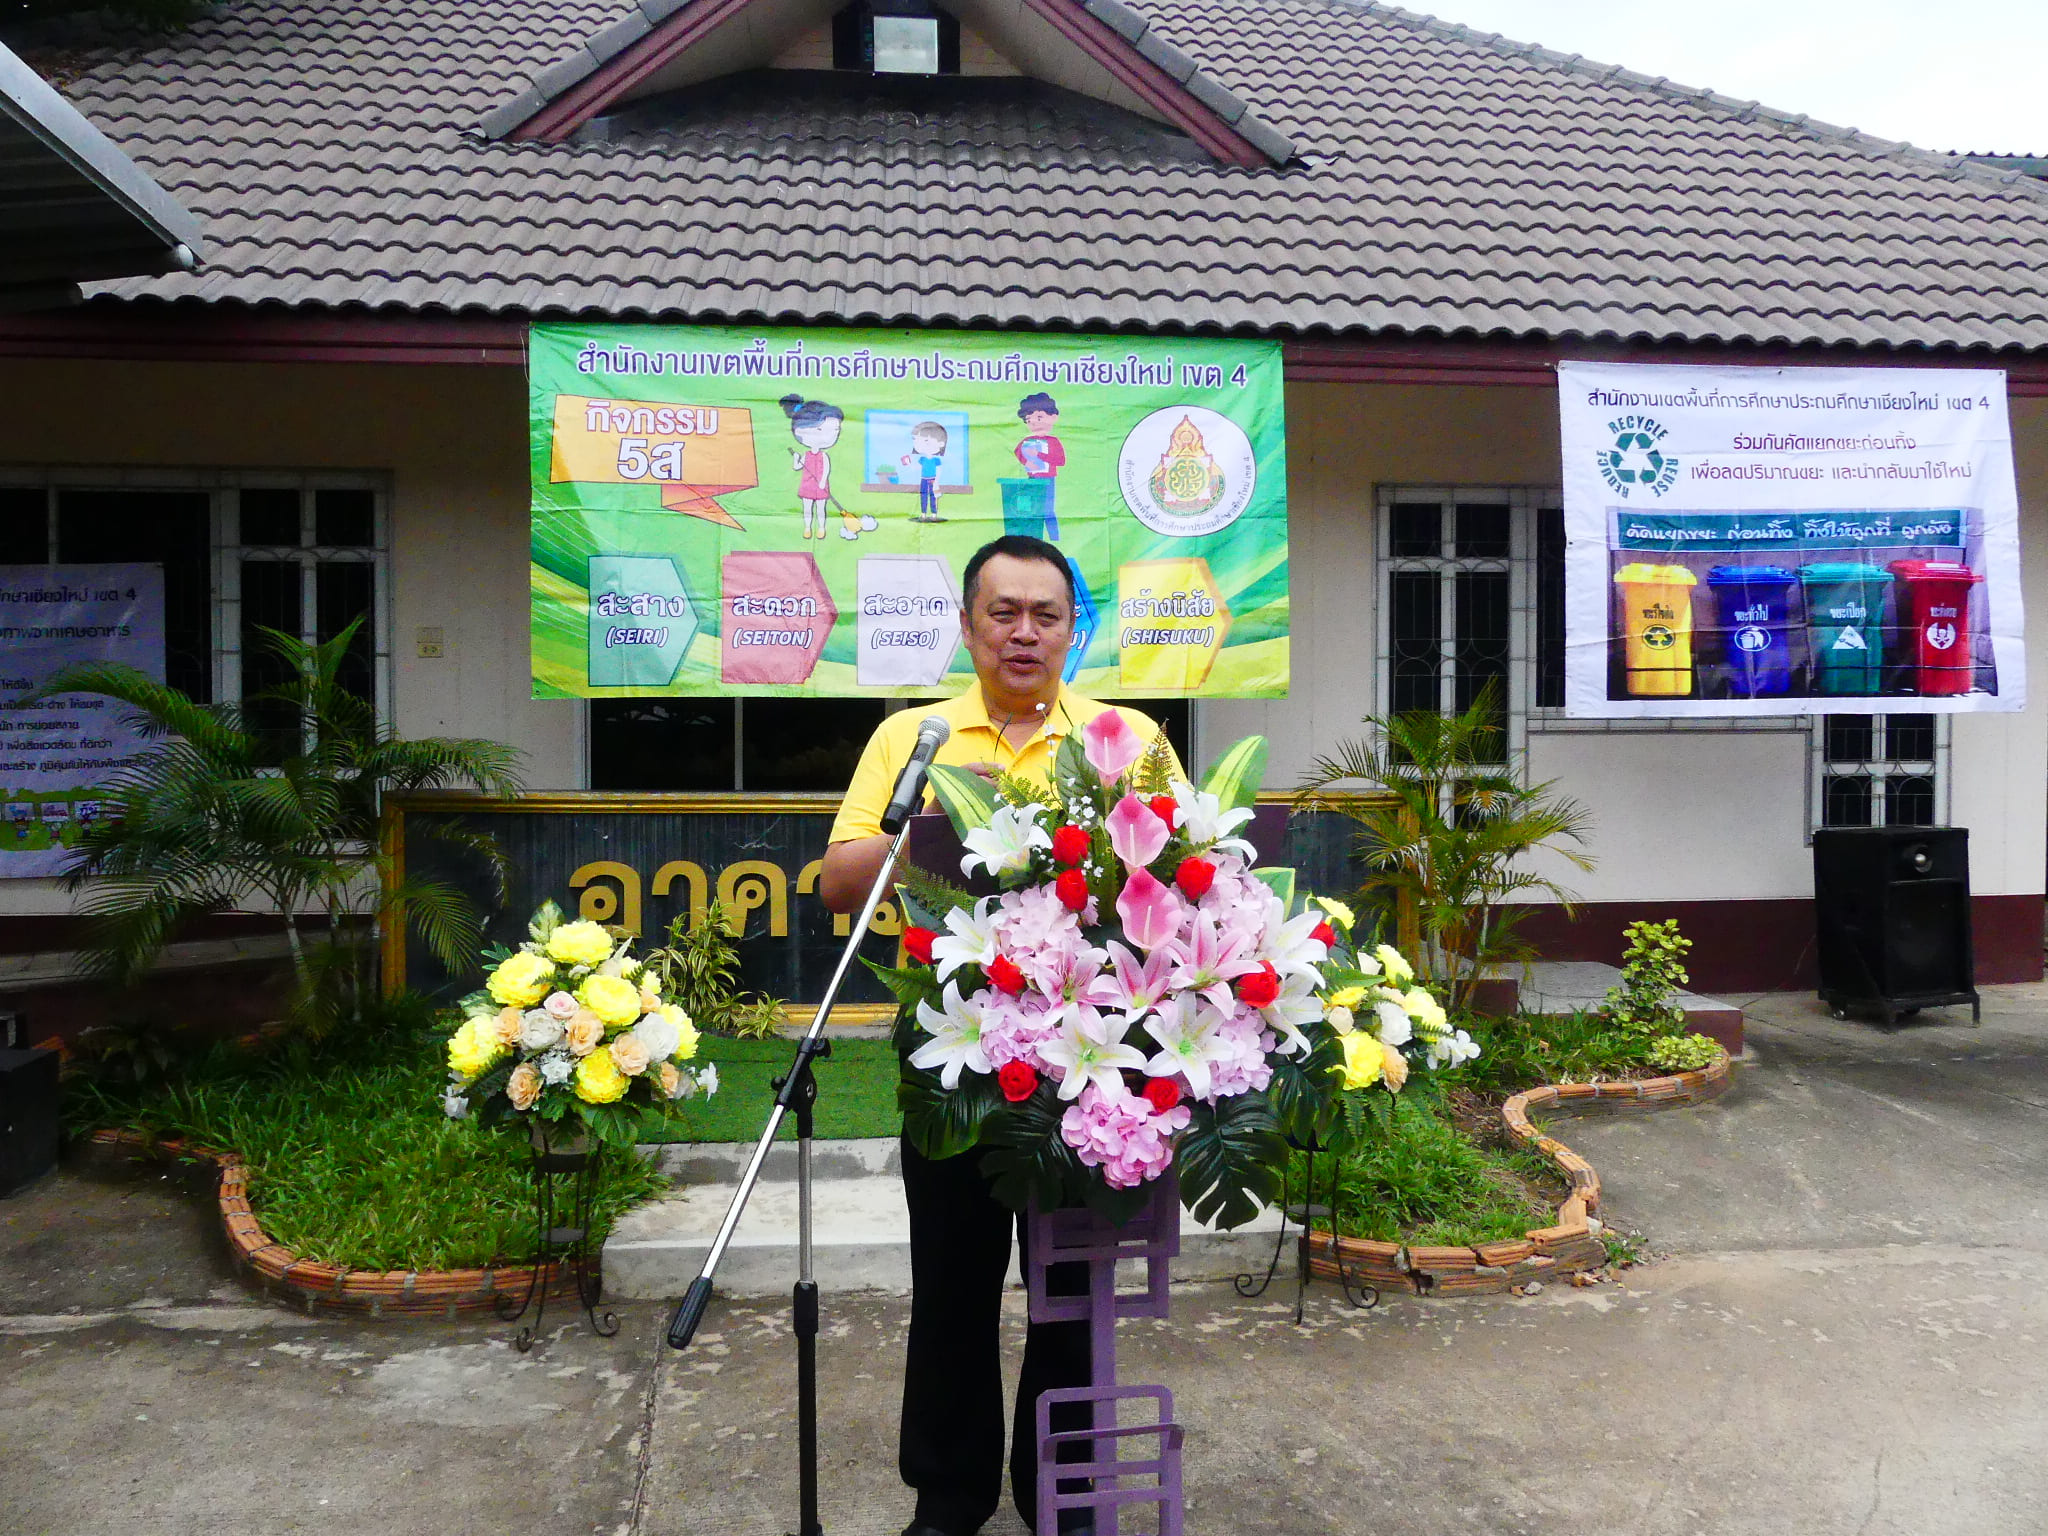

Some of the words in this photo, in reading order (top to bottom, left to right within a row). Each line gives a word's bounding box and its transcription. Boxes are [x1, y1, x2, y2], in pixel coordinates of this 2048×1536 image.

[578, 340, 1173, 387] สำนักงานเขตพื้นที่การศึกษาประถมศึกษาเชียงใหม่
[1182, 363, 1222, 388] เขต
[1231, 364, 1247, 387] 4
[1588, 388, 1939, 410] สำนักงานเขตพื้นที่การศึกษาประถมศึกษาเชียงใหม่
[1946, 397, 1972, 410] เขต
[1979, 396, 1990, 410] 4
[586, 400, 719, 435] กิจกรรม
[1607, 415, 1669, 440] RECYCLE
[1733, 431, 1917, 450] ร่วมกันคัดแยกขยะก่อนทิ้ง
[617, 438, 685, 481] 5ส
[1691, 459, 1824, 480] เพื่อลดปริมาณขยะ
[1832, 461, 1972, 480] และนำกลับมาใช้ใหม่
[1597, 450, 1630, 499] REDUCE
[1651, 458, 1679, 498] REUSE
[126, 587, 136, 600] 4
[1121, 588, 1214, 619] สร้างนิสัย
[597, 593, 685, 618] สะสาง
[732, 594, 817, 618] สะดวก
[864, 594, 948, 617] สะอาด
[605, 626, 669, 648] (SEIRI)
[732, 627, 813, 649] (SEITON)
[871, 629, 939, 650] (SEISO)
[1121, 626, 1214, 648] (SHISUKU)
